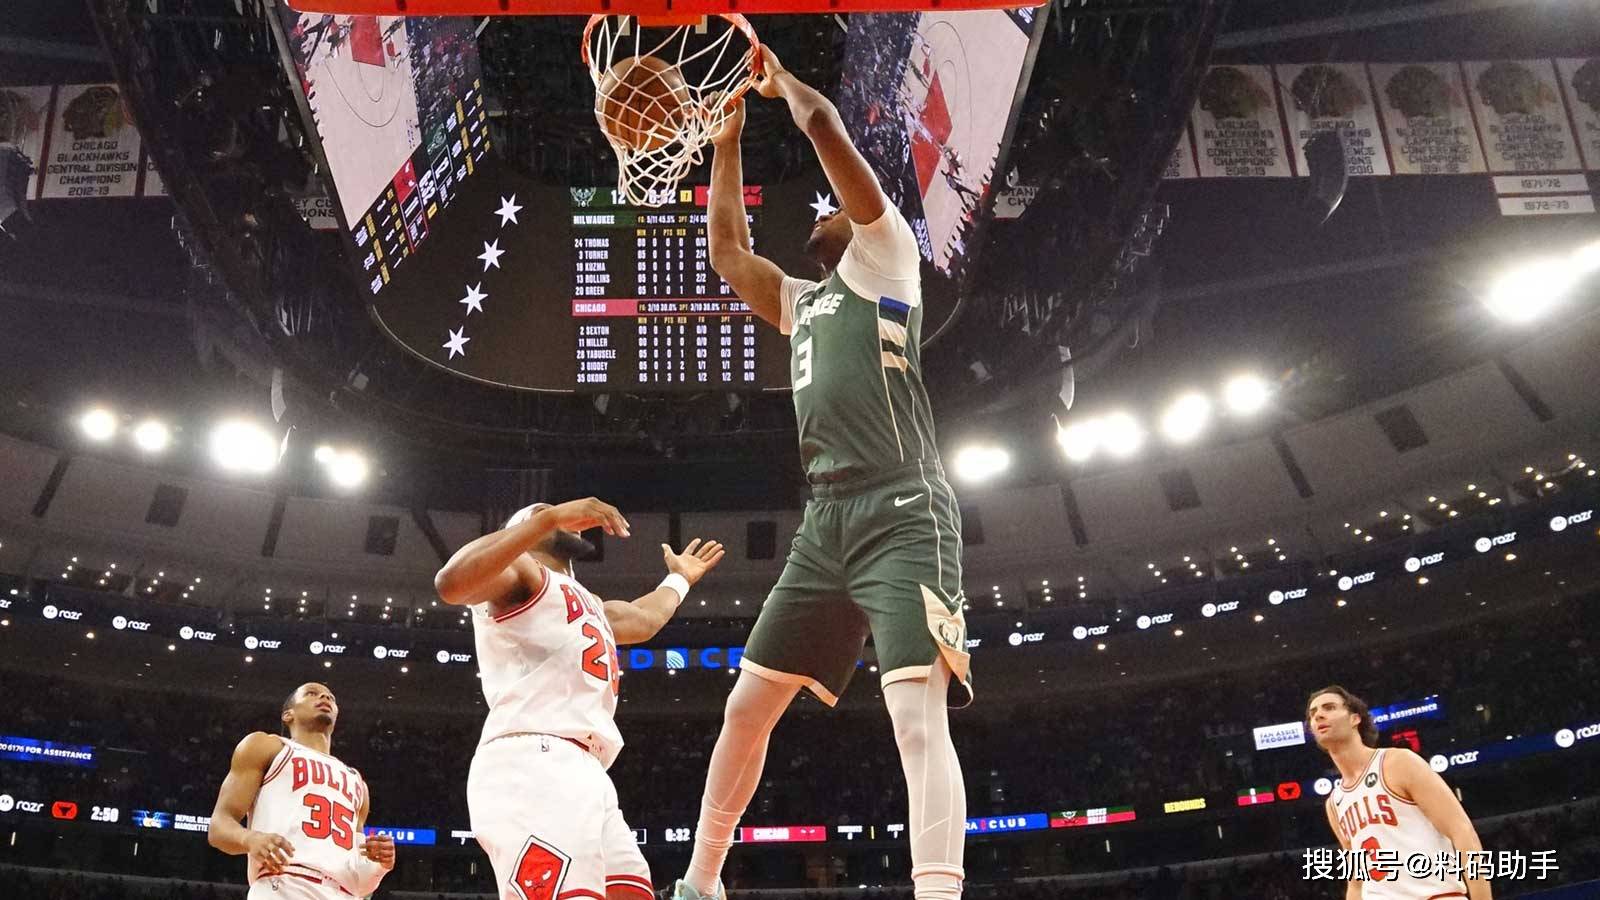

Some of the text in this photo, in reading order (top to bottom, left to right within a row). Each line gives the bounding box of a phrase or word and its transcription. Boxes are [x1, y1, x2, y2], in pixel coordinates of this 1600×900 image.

[72, 141, 118, 150] CHICAGO
[57, 152, 129, 162] BLACKHAWKS
[47, 163, 93, 174] CENTRAL
[95, 162, 137, 172] DIVISION
[59, 174, 121, 184] CHAMPIONS
[68, 186, 110, 196] 2012-13
[573, 216, 615, 224] MILWAUKEE
[585, 238, 609, 247] THOMAS
[585, 250, 608, 259] TURNER
[585, 262, 605, 271] KUZMA
[585, 274, 610, 283] ROLLINS
[586, 286, 604, 295] GREEN
[575, 304, 606, 312] CHICAGO
[586, 326, 609, 335] SEXTON
[586, 338, 607, 347] MILLER
[586, 350, 616, 358] YABUSELE
[587, 374, 606, 382] OKORO
[1568, 510, 1593, 525] razr
[1492, 532, 1516, 546] razr
[1421, 552, 1444, 566] razr
[1353, 571, 1375, 585] razr
[1285, 588, 1308, 600] razr
[1217, 601, 1239, 612] razr
[58, 610, 82, 620] razr
[1152, 613, 1173, 624] razr
[128, 620, 151, 630] razr
[1088, 625, 1109, 635] razr
[194, 631, 216, 640] razr
[1023, 632, 1044, 642] razr
[259, 640, 281, 648] razr
[324, 645, 346, 653] razr
[388, 649, 409, 658] razr
[451, 654, 472, 662] razr
[1390, 703, 1437, 719] ASSISTANCE
[1261, 735, 1300, 744] PROGRAM
[44, 748, 92, 760] ASSISTANCE
[1450, 750, 1479, 766] razr
[292, 757, 364, 812] BULLS
[16, 800, 119, 822] razr 2:50
[302, 793, 355, 850] 35
[1339, 794, 1399, 840] BULLS
[989, 818, 1026, 829] CLUB
